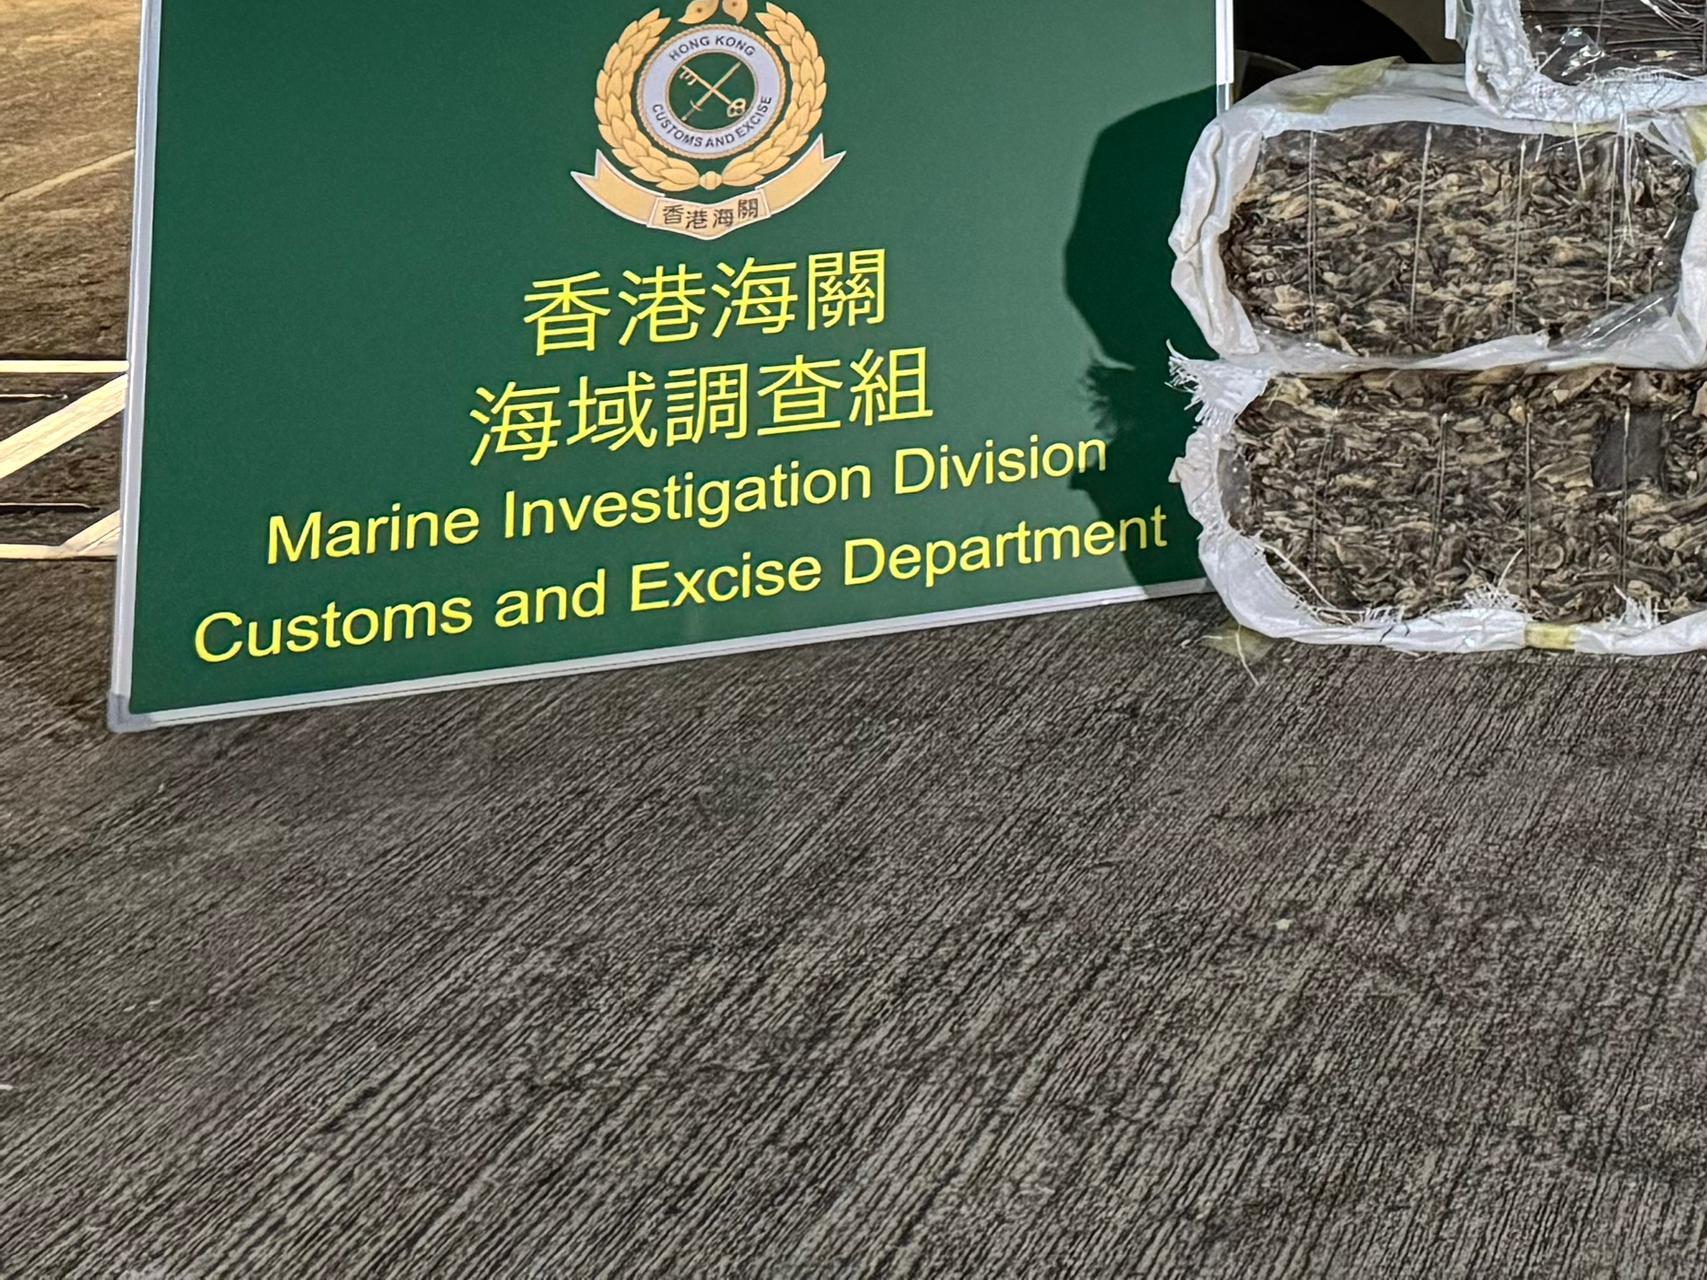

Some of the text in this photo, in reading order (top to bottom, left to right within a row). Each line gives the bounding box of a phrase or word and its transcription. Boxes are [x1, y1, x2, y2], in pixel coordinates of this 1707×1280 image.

[668, 35, 756, 61] HONG KONG
[652, 96, 772, 147] CUSTOMS AND EXCISE
[663, 197, 759, 229] 香港海關
[522, 248, 886, 355] 香港海關
[469, 347, 934, 466] 海域調查組
[268, 437, 1107, 565] Marine Investigation Division
[195, 505, 1167, 663] Customs and Excise Department
